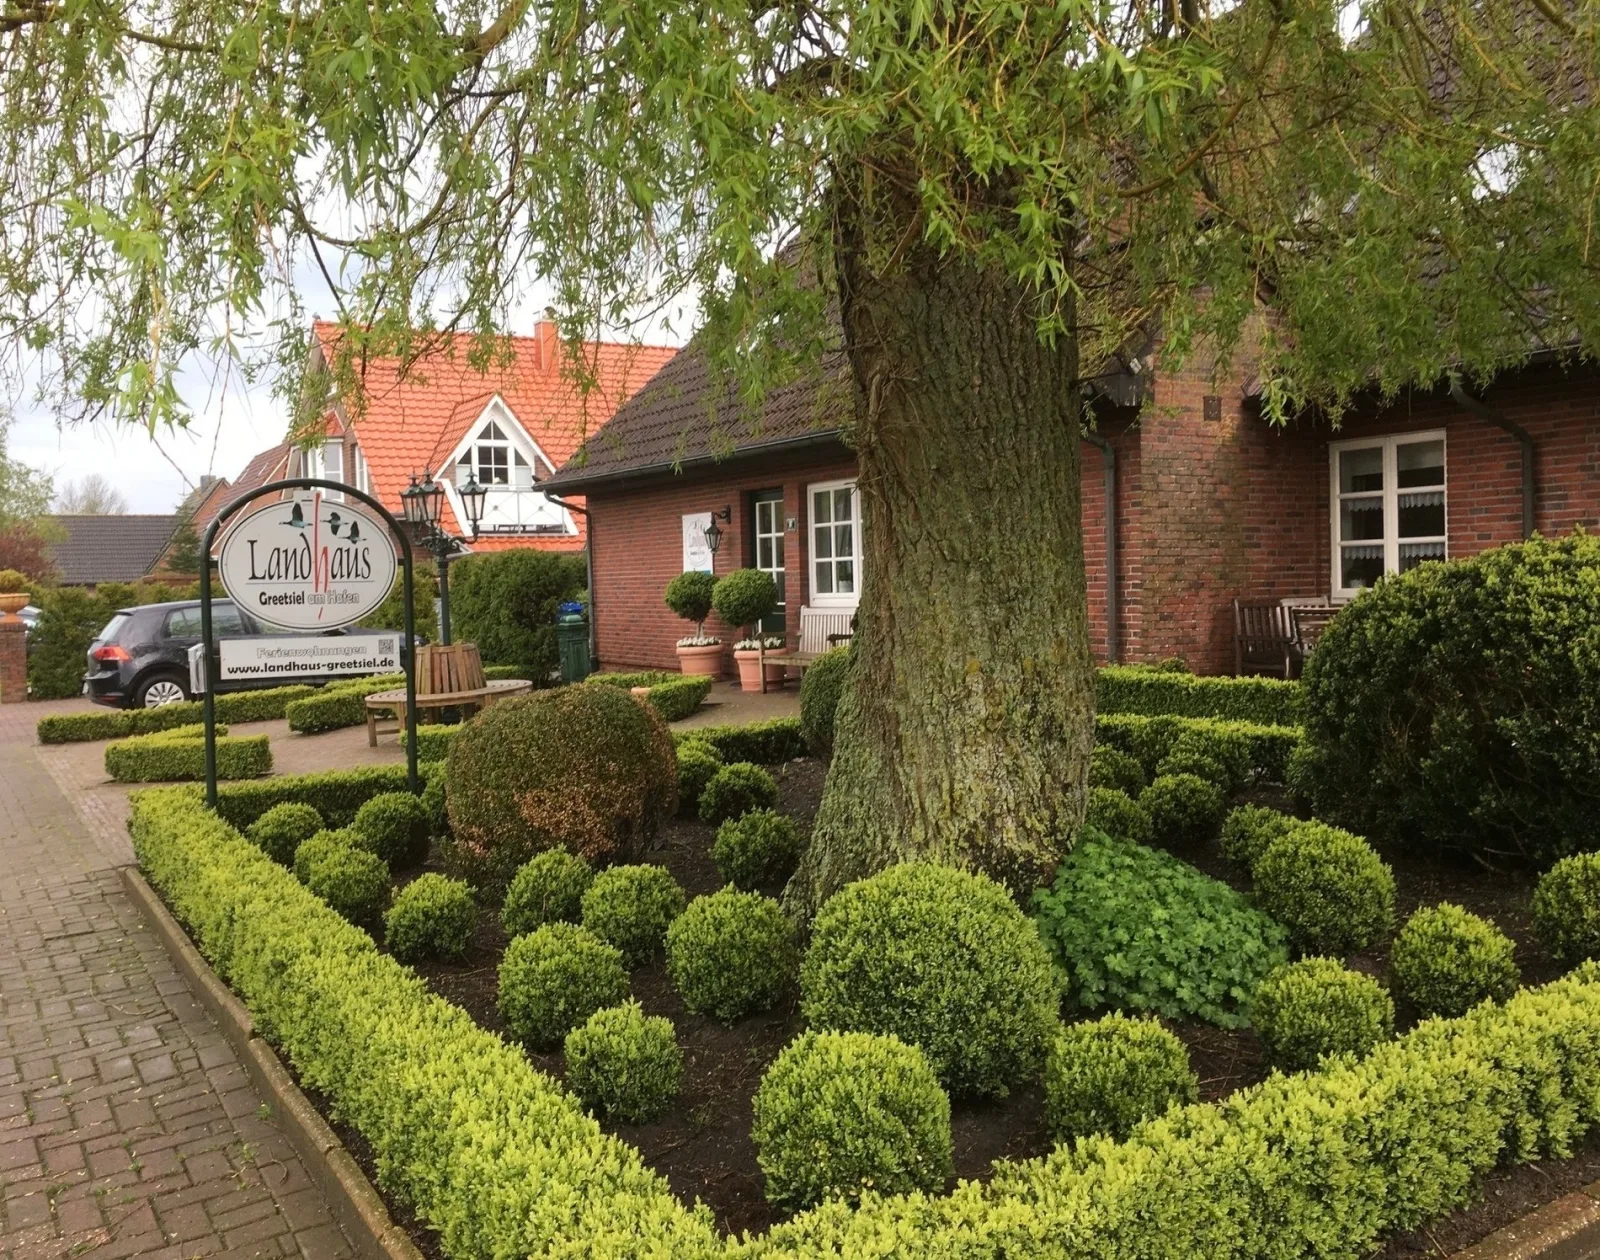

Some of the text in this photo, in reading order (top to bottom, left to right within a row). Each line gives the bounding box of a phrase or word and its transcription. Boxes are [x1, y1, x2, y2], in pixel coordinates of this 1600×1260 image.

[247, 493, 371, 593] Landhaus
[259, 589, 360, 606] Greetsiel am Hafen
[256, 645, 367, 660] Ferienwohnungen
[227, 657, 394, 674] www.landhaus-greetsiel.de
